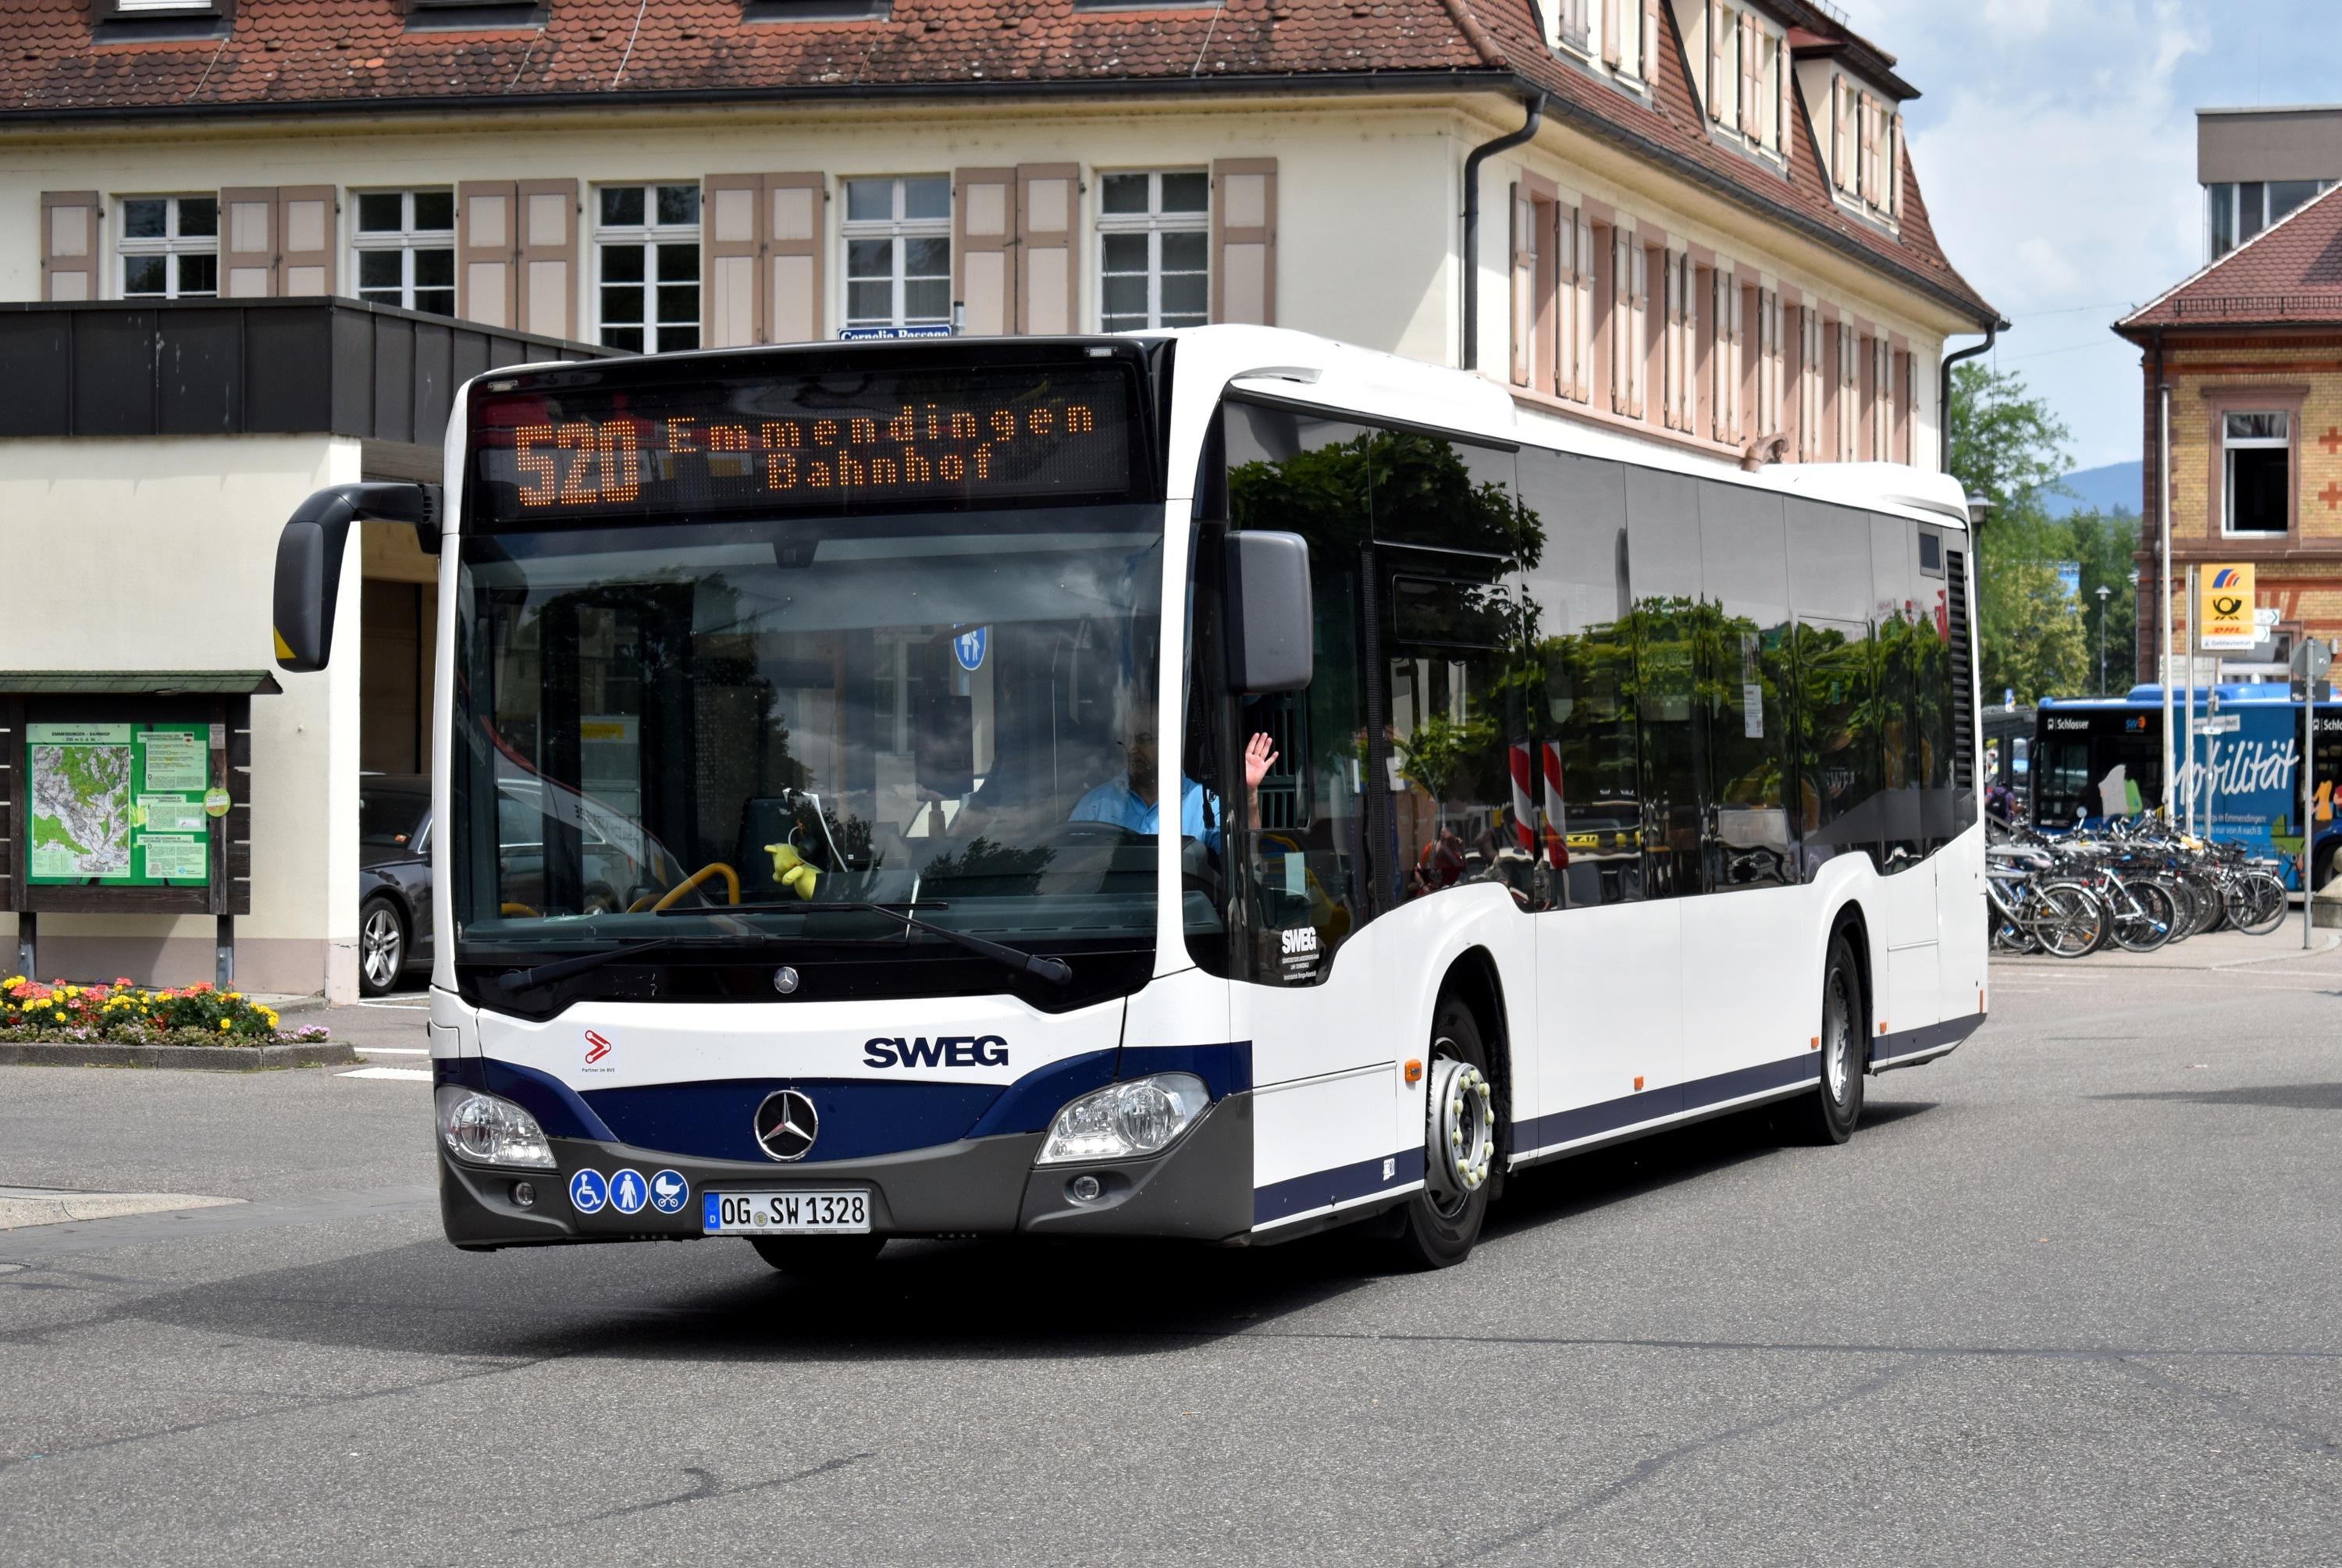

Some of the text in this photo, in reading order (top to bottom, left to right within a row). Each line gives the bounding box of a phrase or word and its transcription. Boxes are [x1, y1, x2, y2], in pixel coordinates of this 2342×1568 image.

[667, 404, 1094, 453] Emmendingen
[515, 421, 639, 506] 520
[767, 442, 992, 489] Bahnhof
[2056, 718, 2090, 731] Schlosser
[1282, 926, 1317, 954] SWEG
[863, 1035, 1009, 1068] SWEG
[721, 1196, 865, 1225] OG SW 1328
